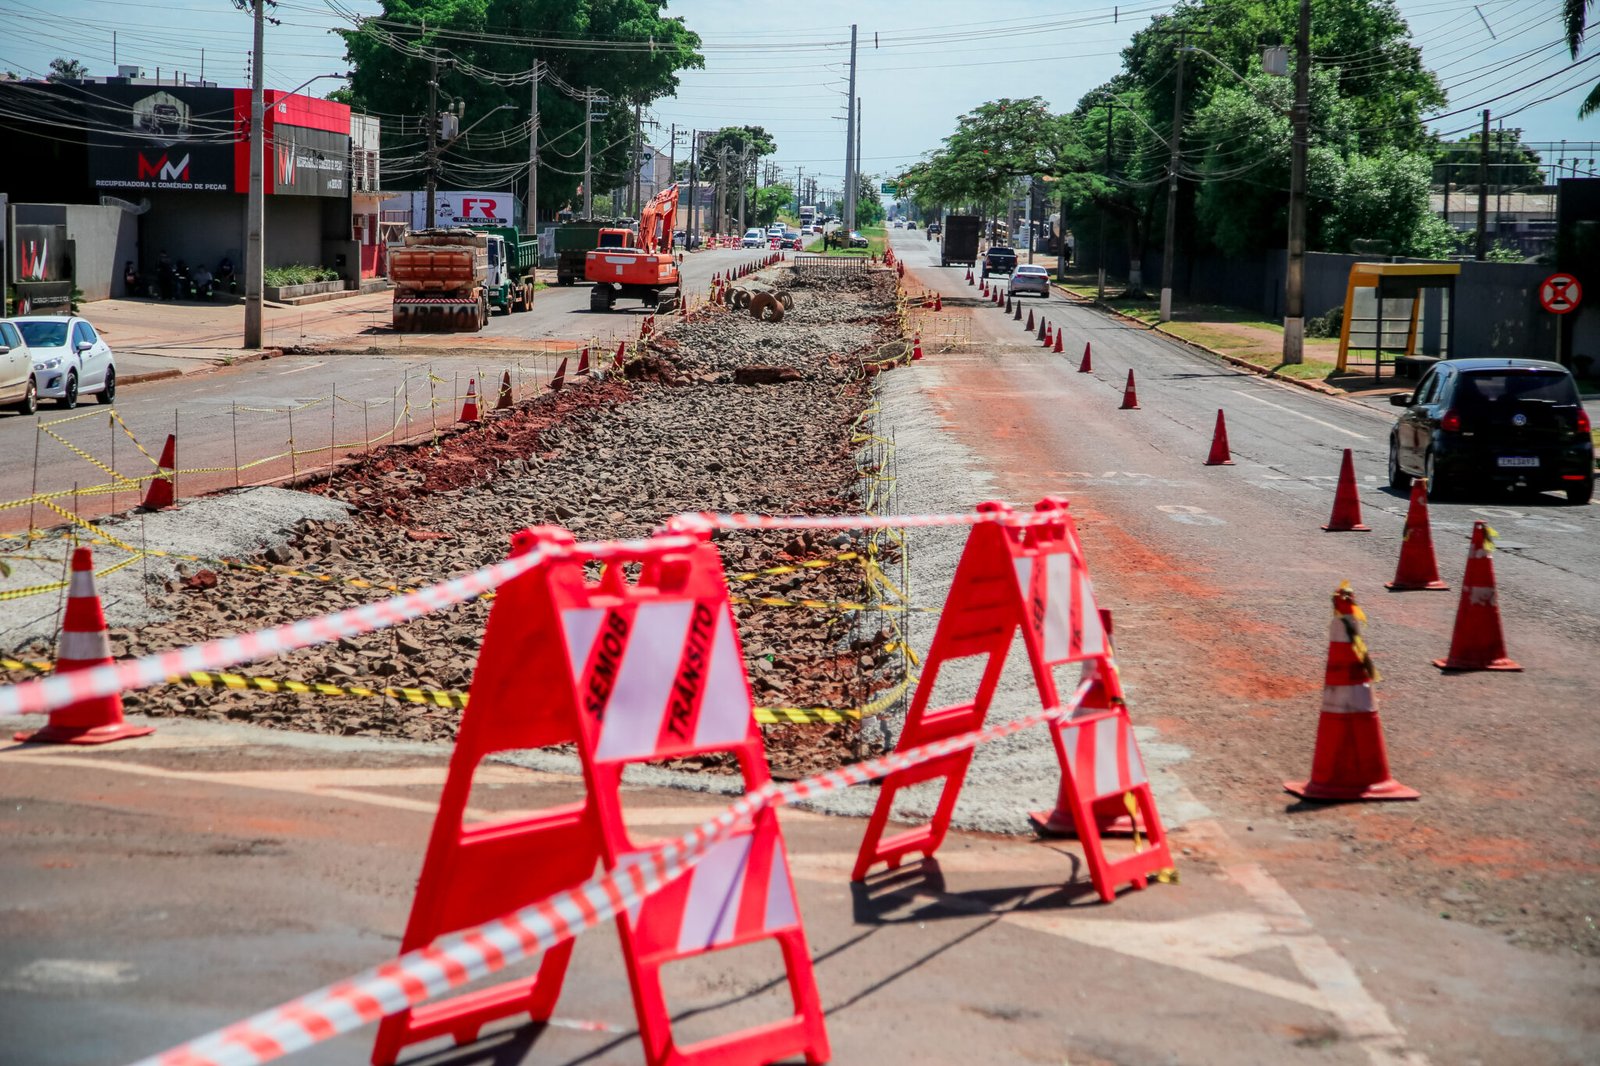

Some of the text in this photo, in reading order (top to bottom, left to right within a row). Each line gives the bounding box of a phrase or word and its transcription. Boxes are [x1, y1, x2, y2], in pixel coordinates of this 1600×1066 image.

[138, 151, 190, 181] MM
[95, 180, 150, 188] RECUPERADORA
[462, 198, 498, 218] FR
[586, 610, 628, 722] SEMOB
